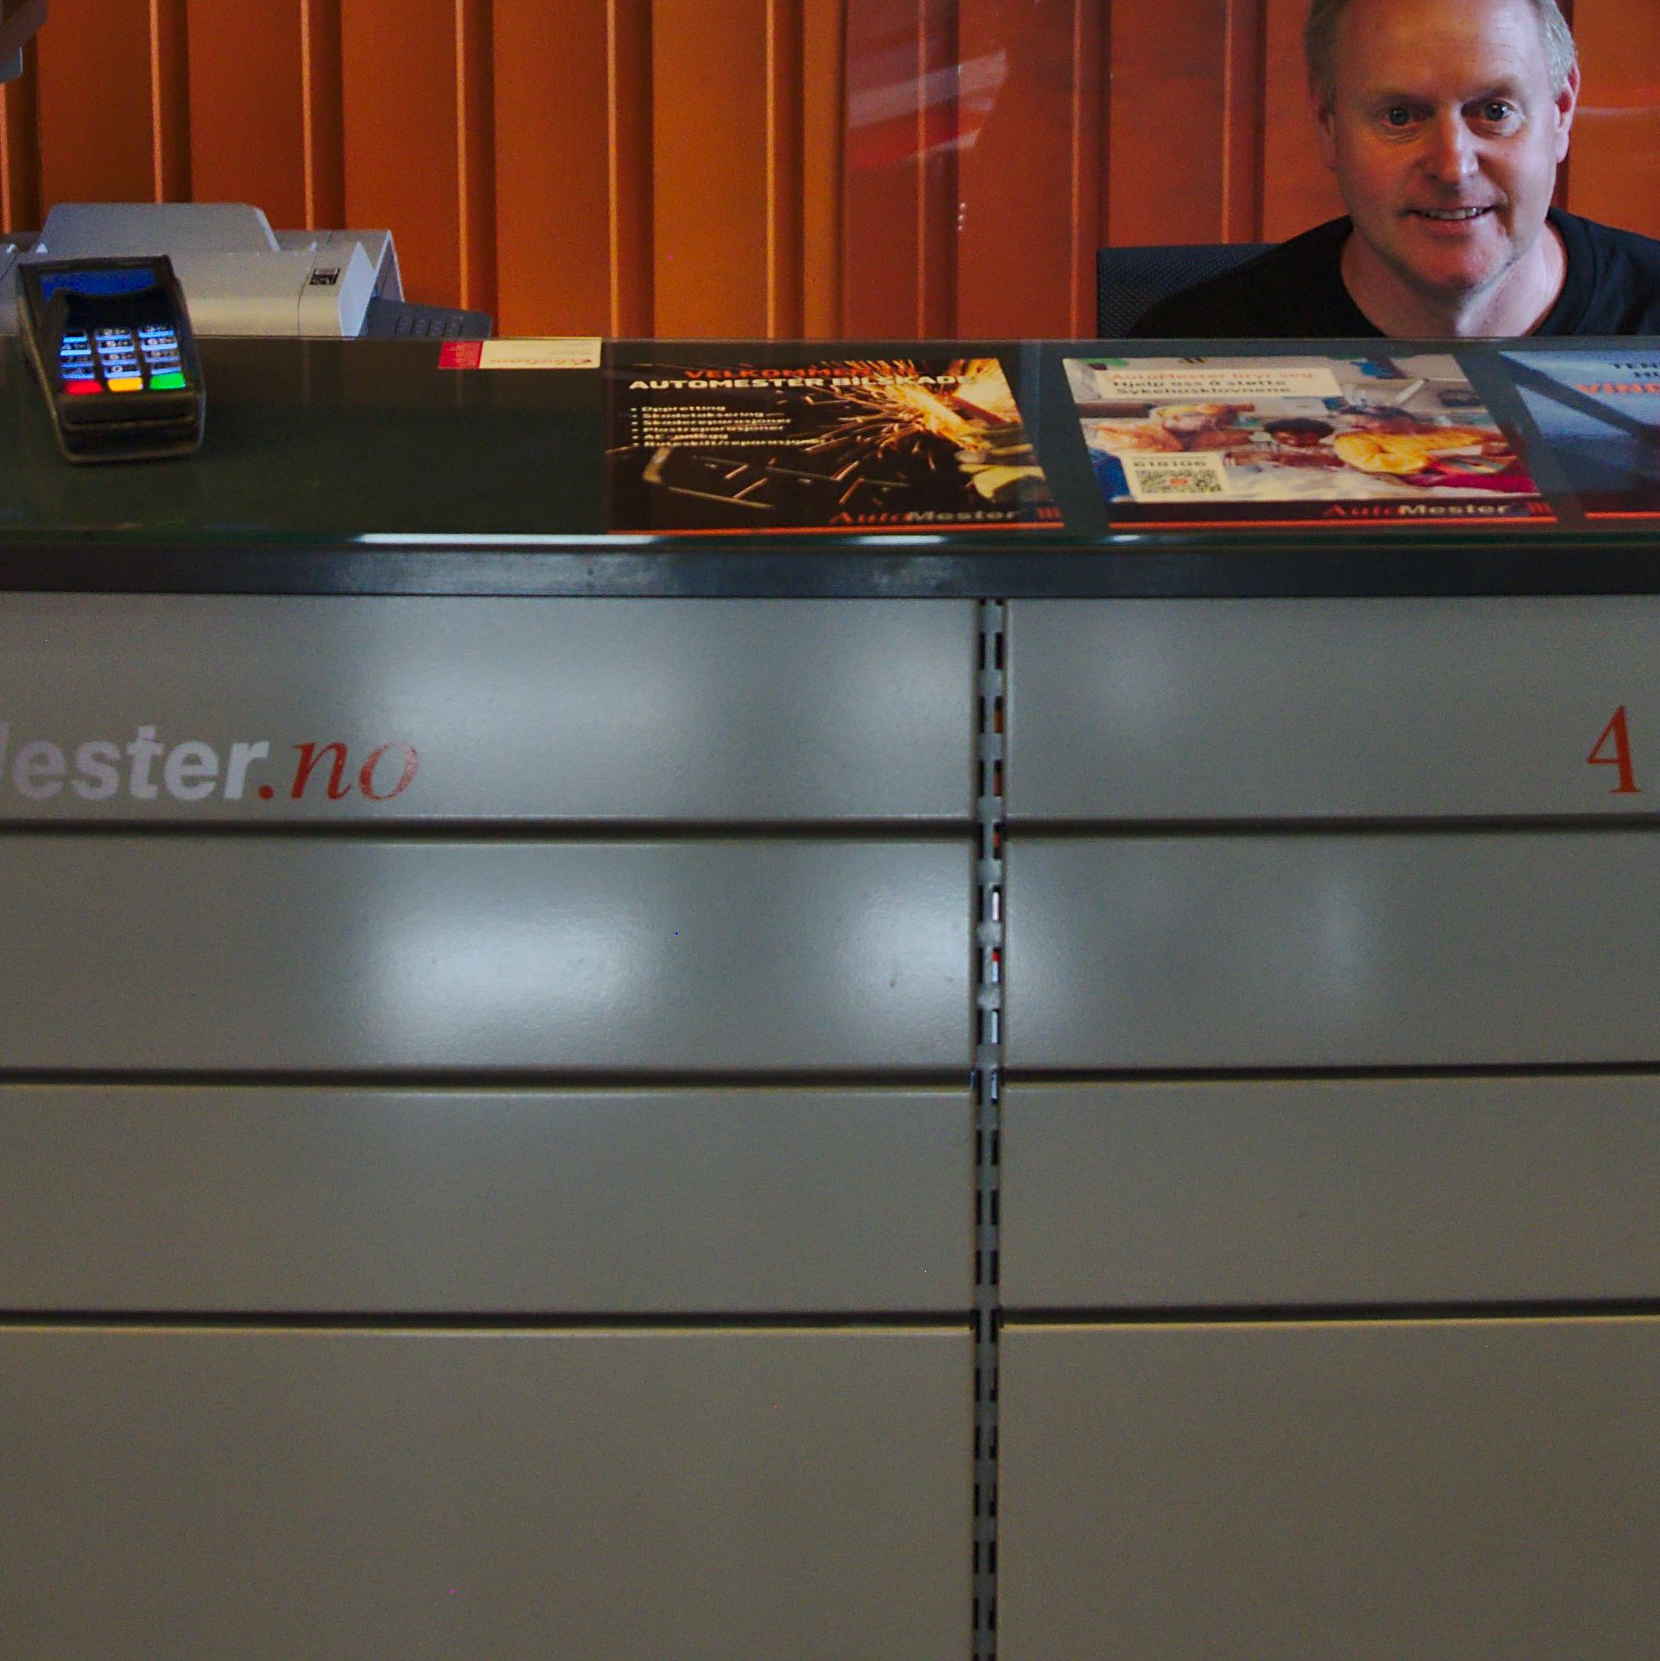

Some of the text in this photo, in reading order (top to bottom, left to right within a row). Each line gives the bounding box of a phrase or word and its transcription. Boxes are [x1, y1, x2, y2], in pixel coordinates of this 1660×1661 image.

[629, 378, 824, 389] AUTOMESTER
[829, 508, 1018, 524] AutoMester
[1323, 503, 1510, 518] AutoMester
